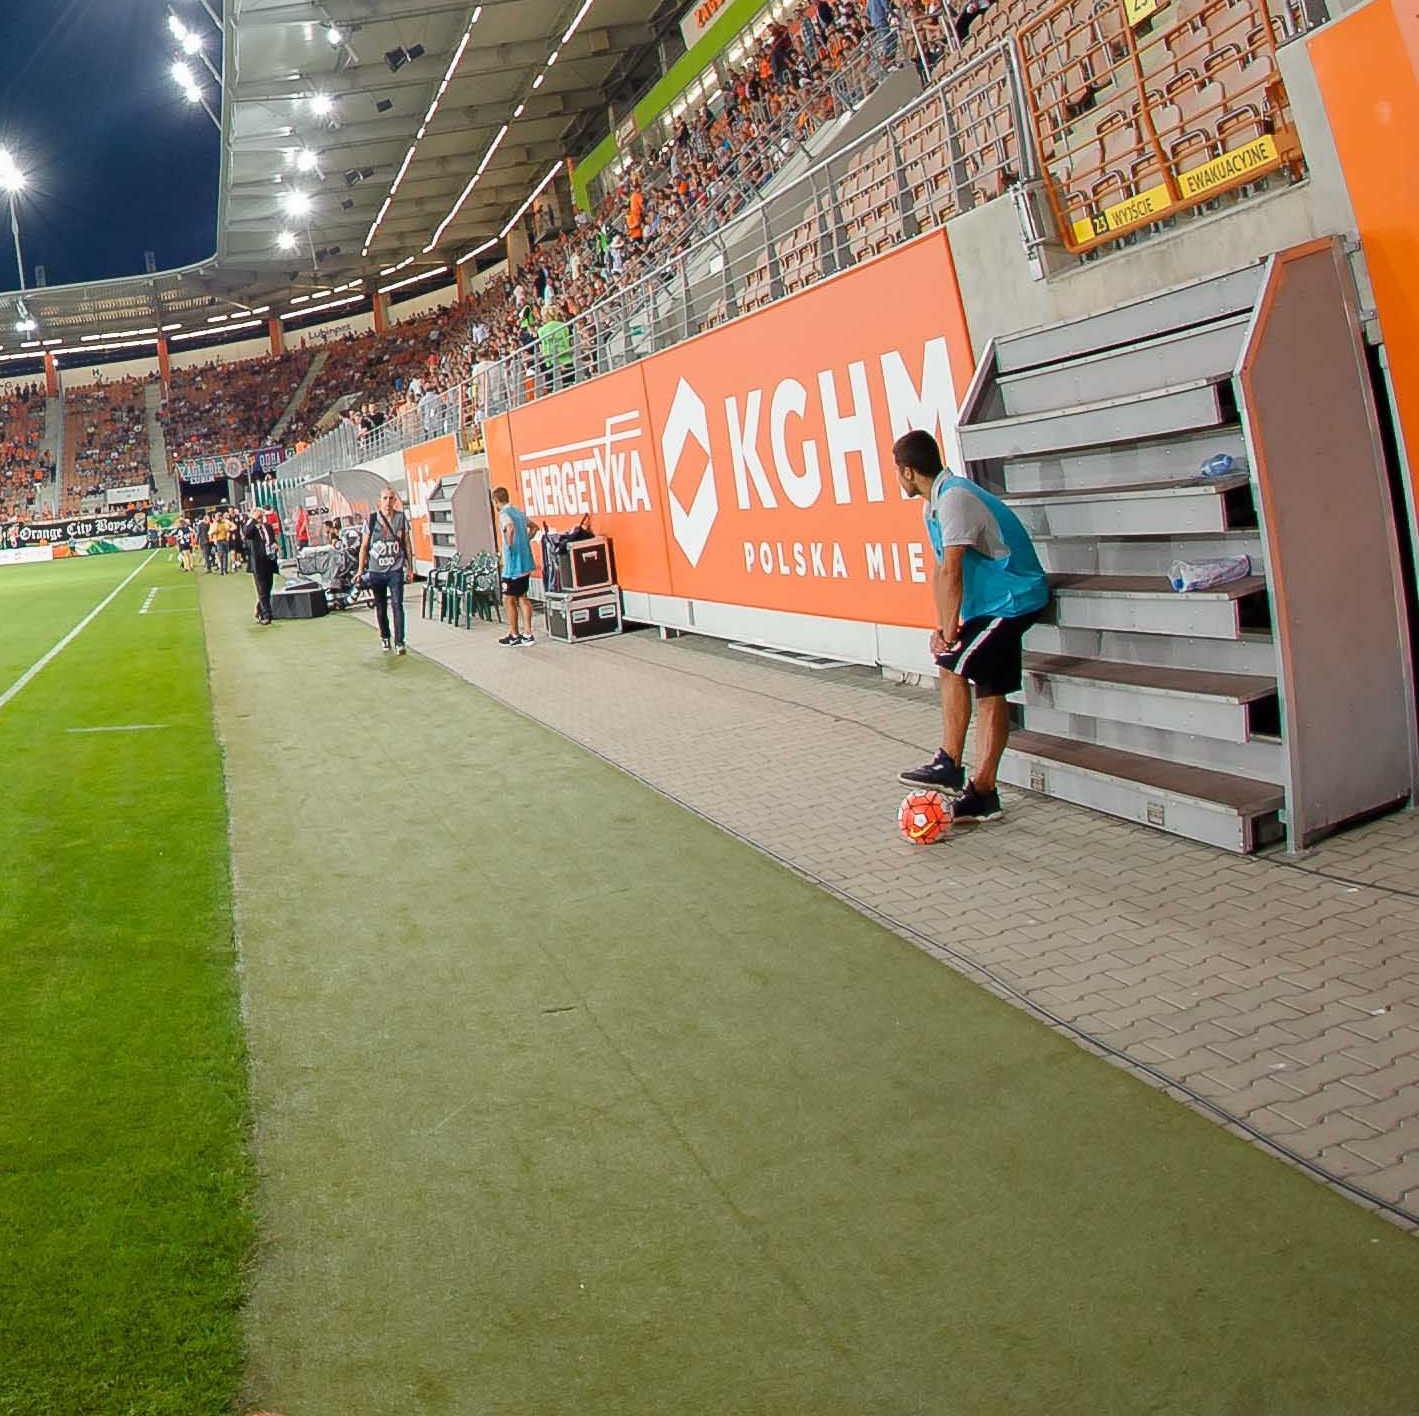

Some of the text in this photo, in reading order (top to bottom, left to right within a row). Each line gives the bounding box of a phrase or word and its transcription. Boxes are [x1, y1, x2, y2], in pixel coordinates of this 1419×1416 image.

[1186, 141, 1270, 193] EWAKUACYJNE
[1093, 196, 1154, 234] 23 WYJŚCIE
[723, 335, 964, 511] KGHM
[519, 446, 652, 518] ENERGETYKA
[18, 526, 63, 541] Orange
[66, 522, 93, 537] City
[743, 541, 927, 583] POLSKA MIE
